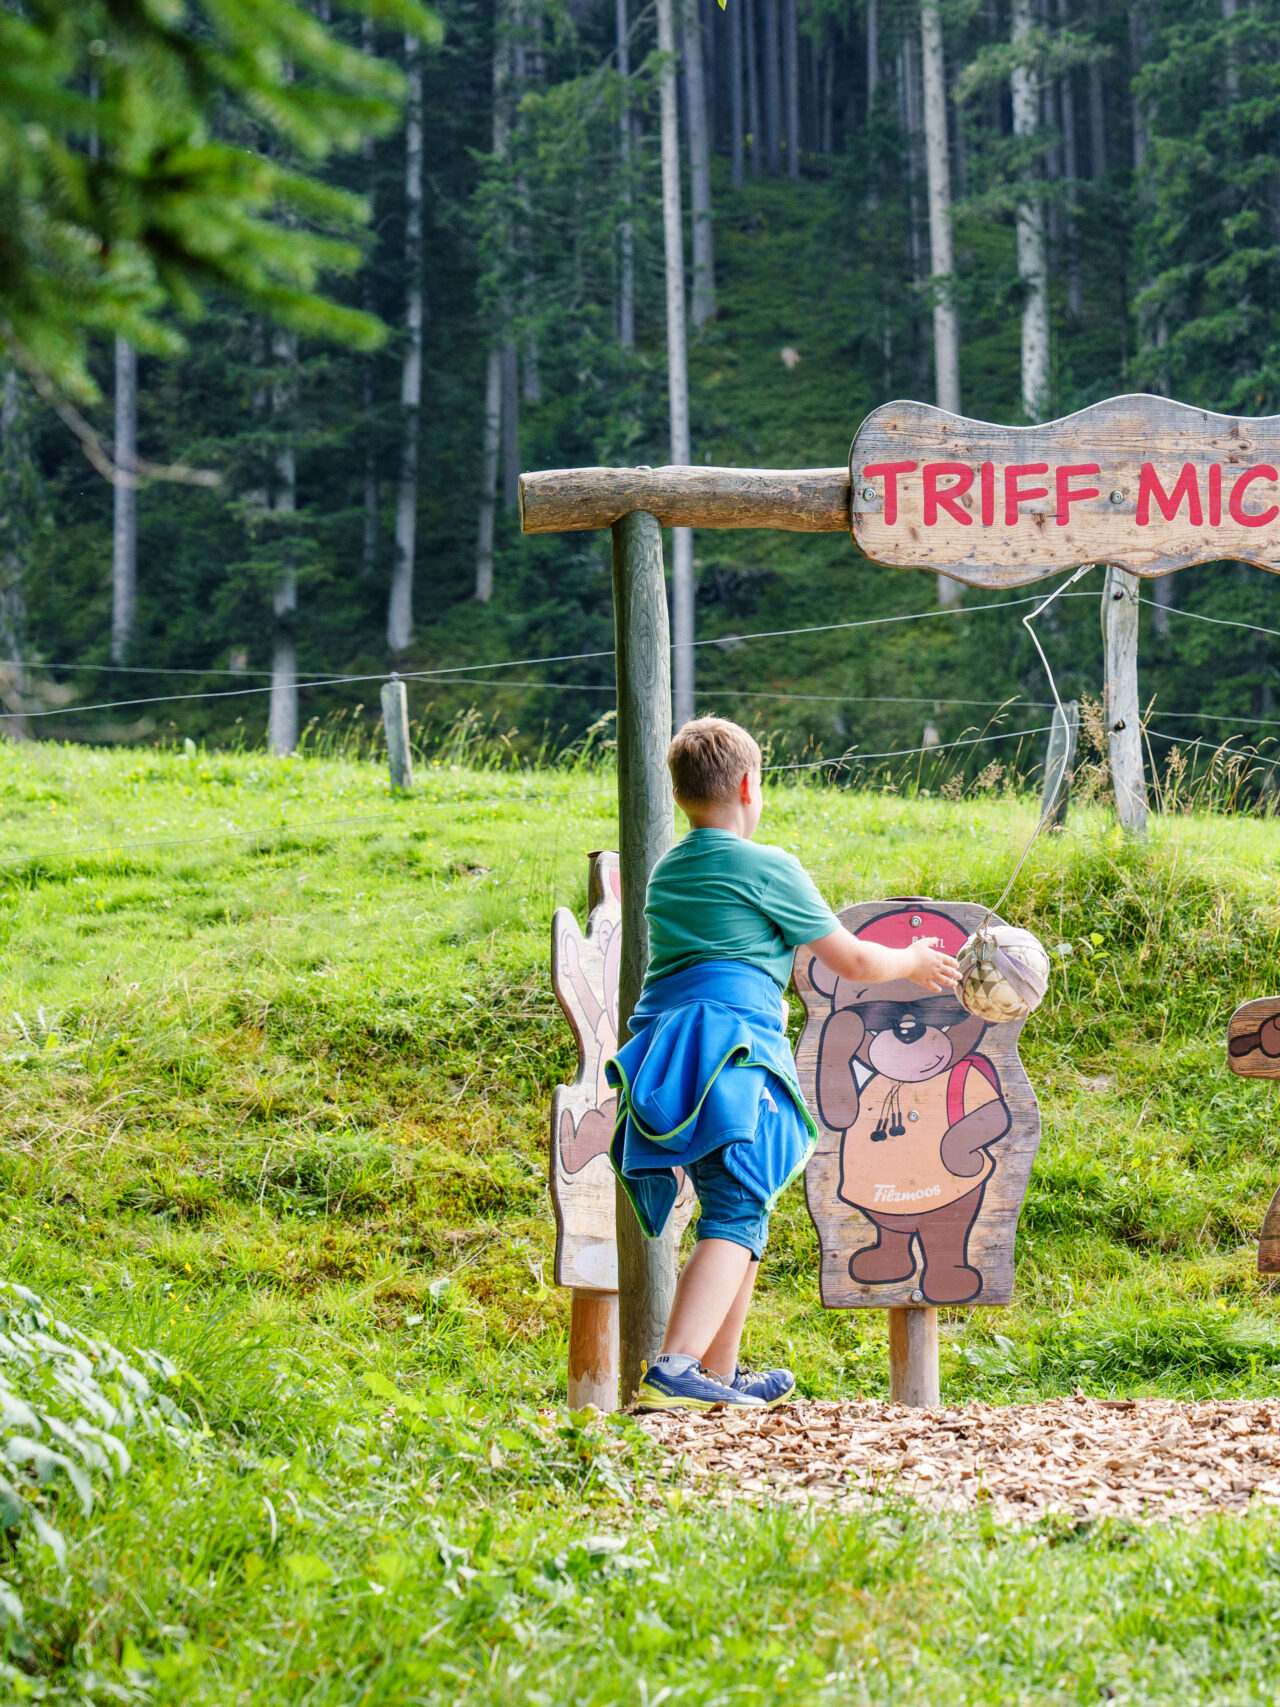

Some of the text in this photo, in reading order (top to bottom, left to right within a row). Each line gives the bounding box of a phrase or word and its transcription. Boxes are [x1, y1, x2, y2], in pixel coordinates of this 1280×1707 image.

[863, 461, 1100, 527] TRIFF
[911, 934, 947, 949] BTL
[873, 1183, 942, 1203] Filzmoos
